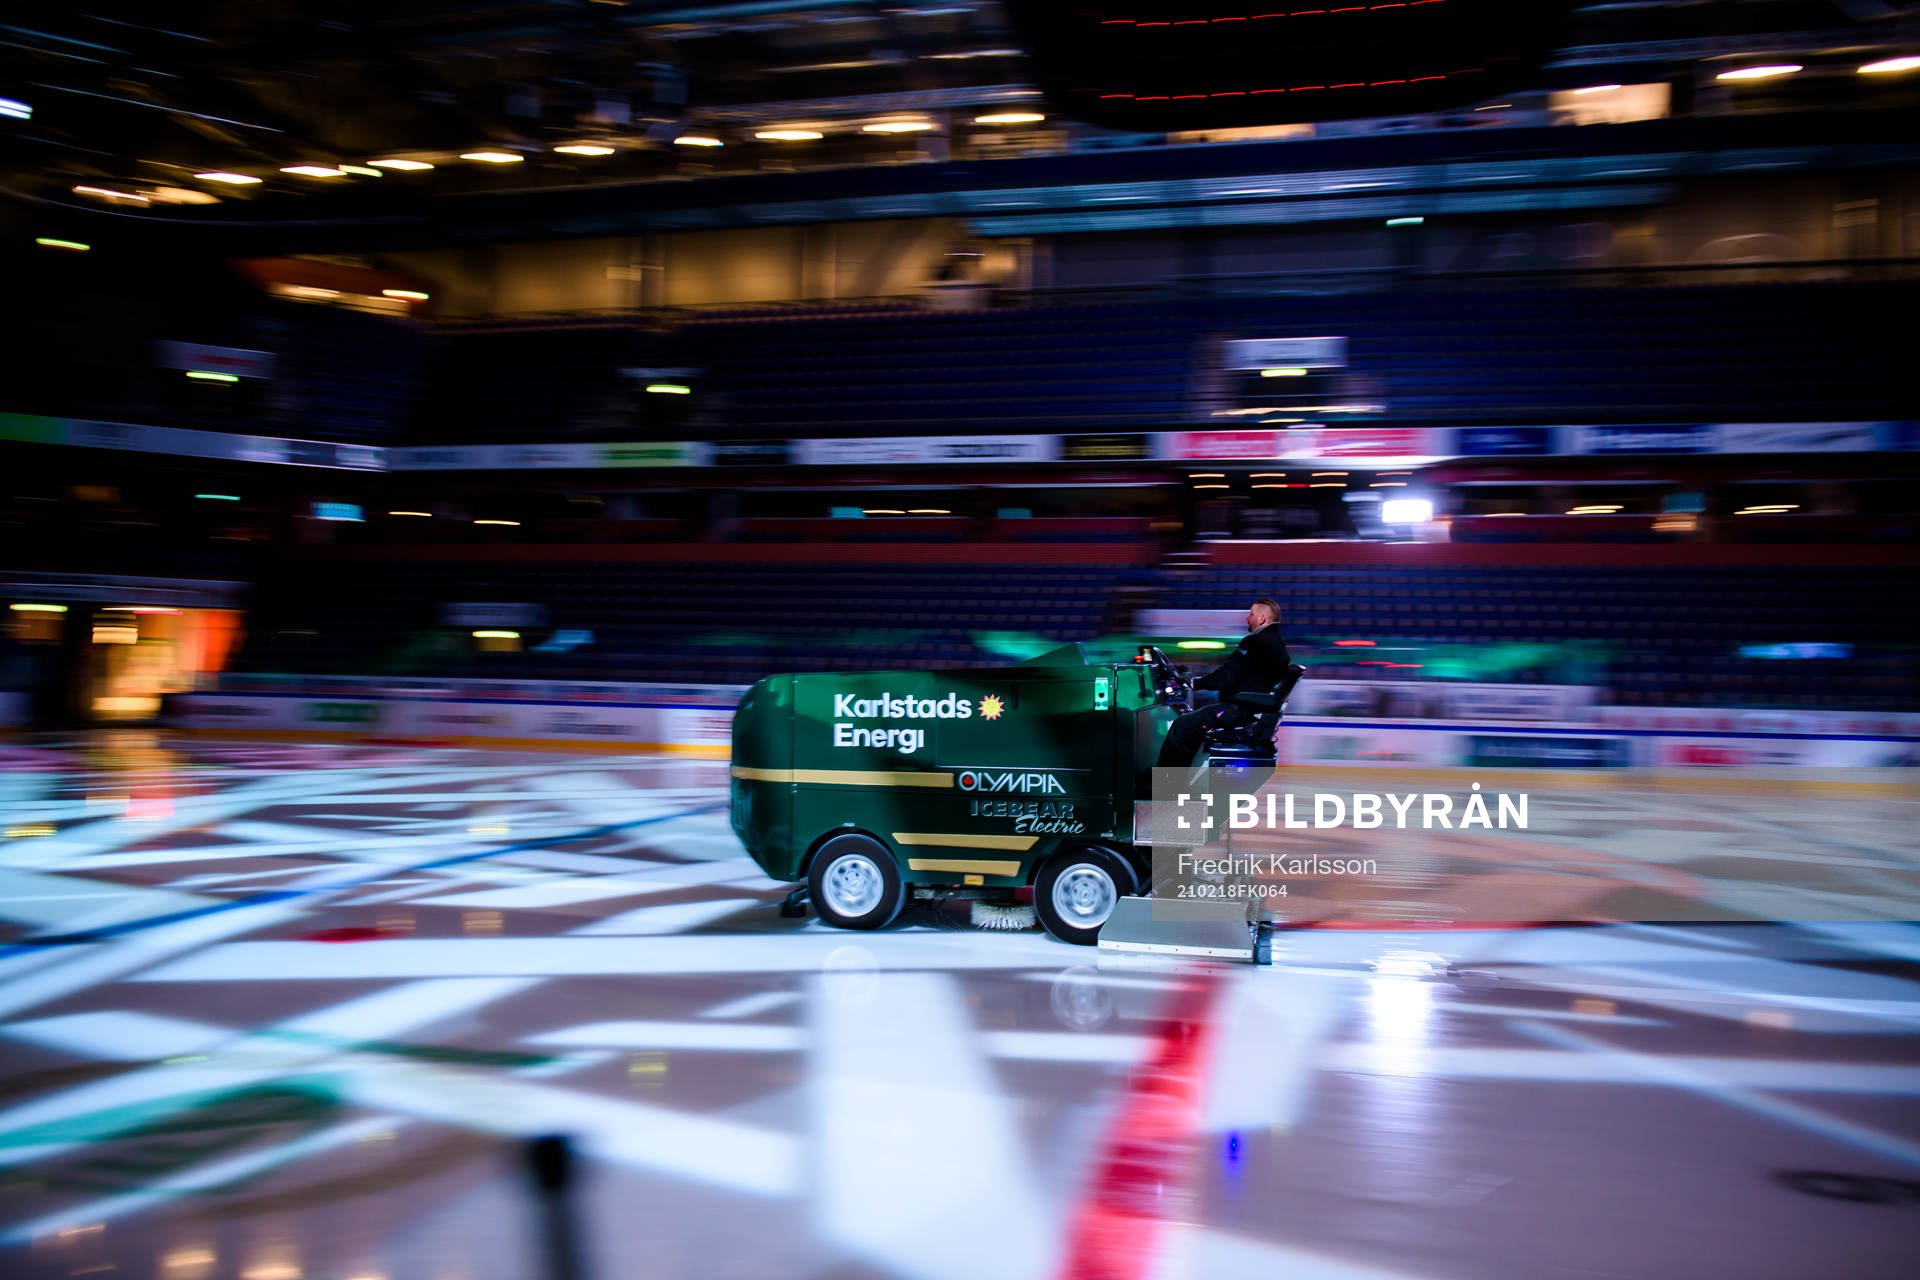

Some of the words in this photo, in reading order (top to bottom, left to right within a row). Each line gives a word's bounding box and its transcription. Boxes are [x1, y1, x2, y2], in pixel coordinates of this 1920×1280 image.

[833, 692, 972, 719] Karlstads
[833, 722, 925, 754] Energi
[959, 770, 1067, 794] OLYMPIA
[970, 800, 1075, 819] ICEBEAR
[1015, 813, 1086, 834] Electric
